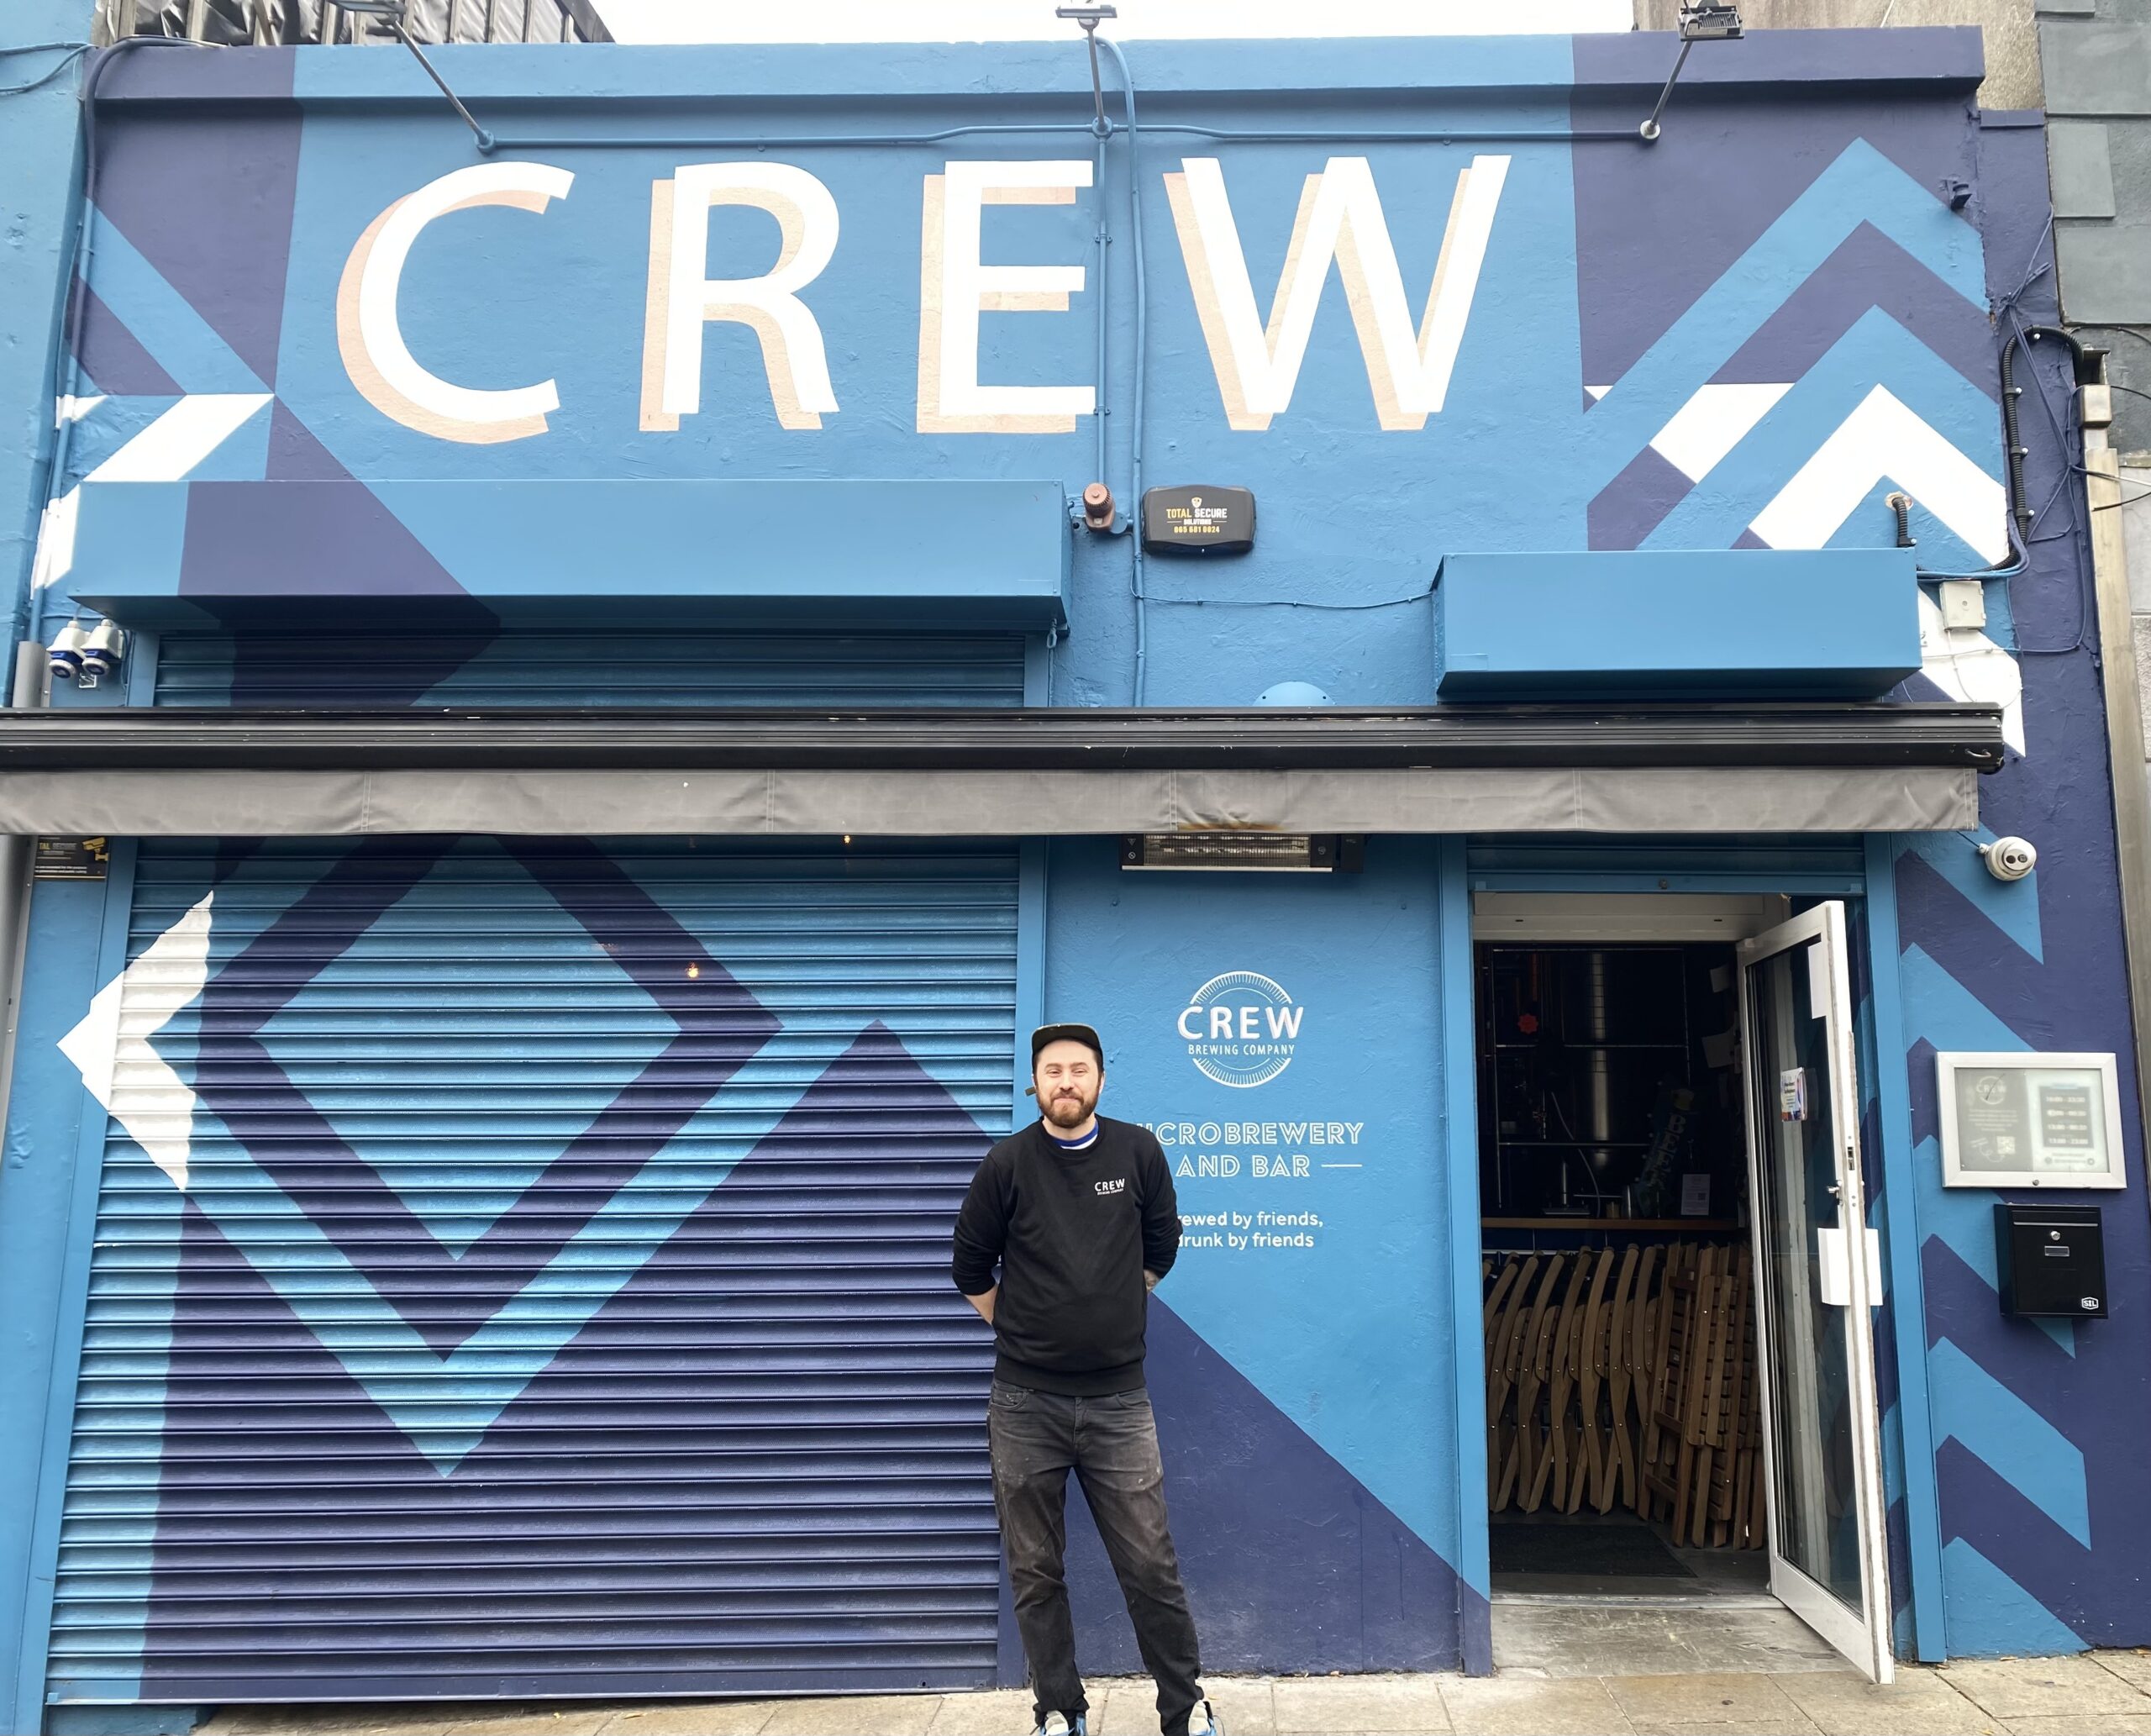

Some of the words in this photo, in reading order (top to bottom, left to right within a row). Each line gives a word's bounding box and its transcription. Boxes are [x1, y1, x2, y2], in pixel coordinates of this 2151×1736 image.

[336, 155, 1512, 444] CREW
[1166, 508, 1192, 518] TOTAL
[1194, 508, 1228, 518] SECURE
[1177, 1006, 1304, 1039] CREW
[1188, 1044, 1239, 1055] BREWING
[1243, 1044, 1295, 1055] COMPANY
[1136, 1122, 1364, 1145] CROBREWERY
[1175, 1154, 1240, 1177] AND
[1252, 1154, 1310, 1177] BAR
[1094, 1178, 1125, 1192] CREW
[1233, 1211, 1253, 1229] by
[1257, 1211, 1323, 1227] friends,
[1228, 1232, 1249, 1250] by
[1252, 1232, 1314, 1247] friends
